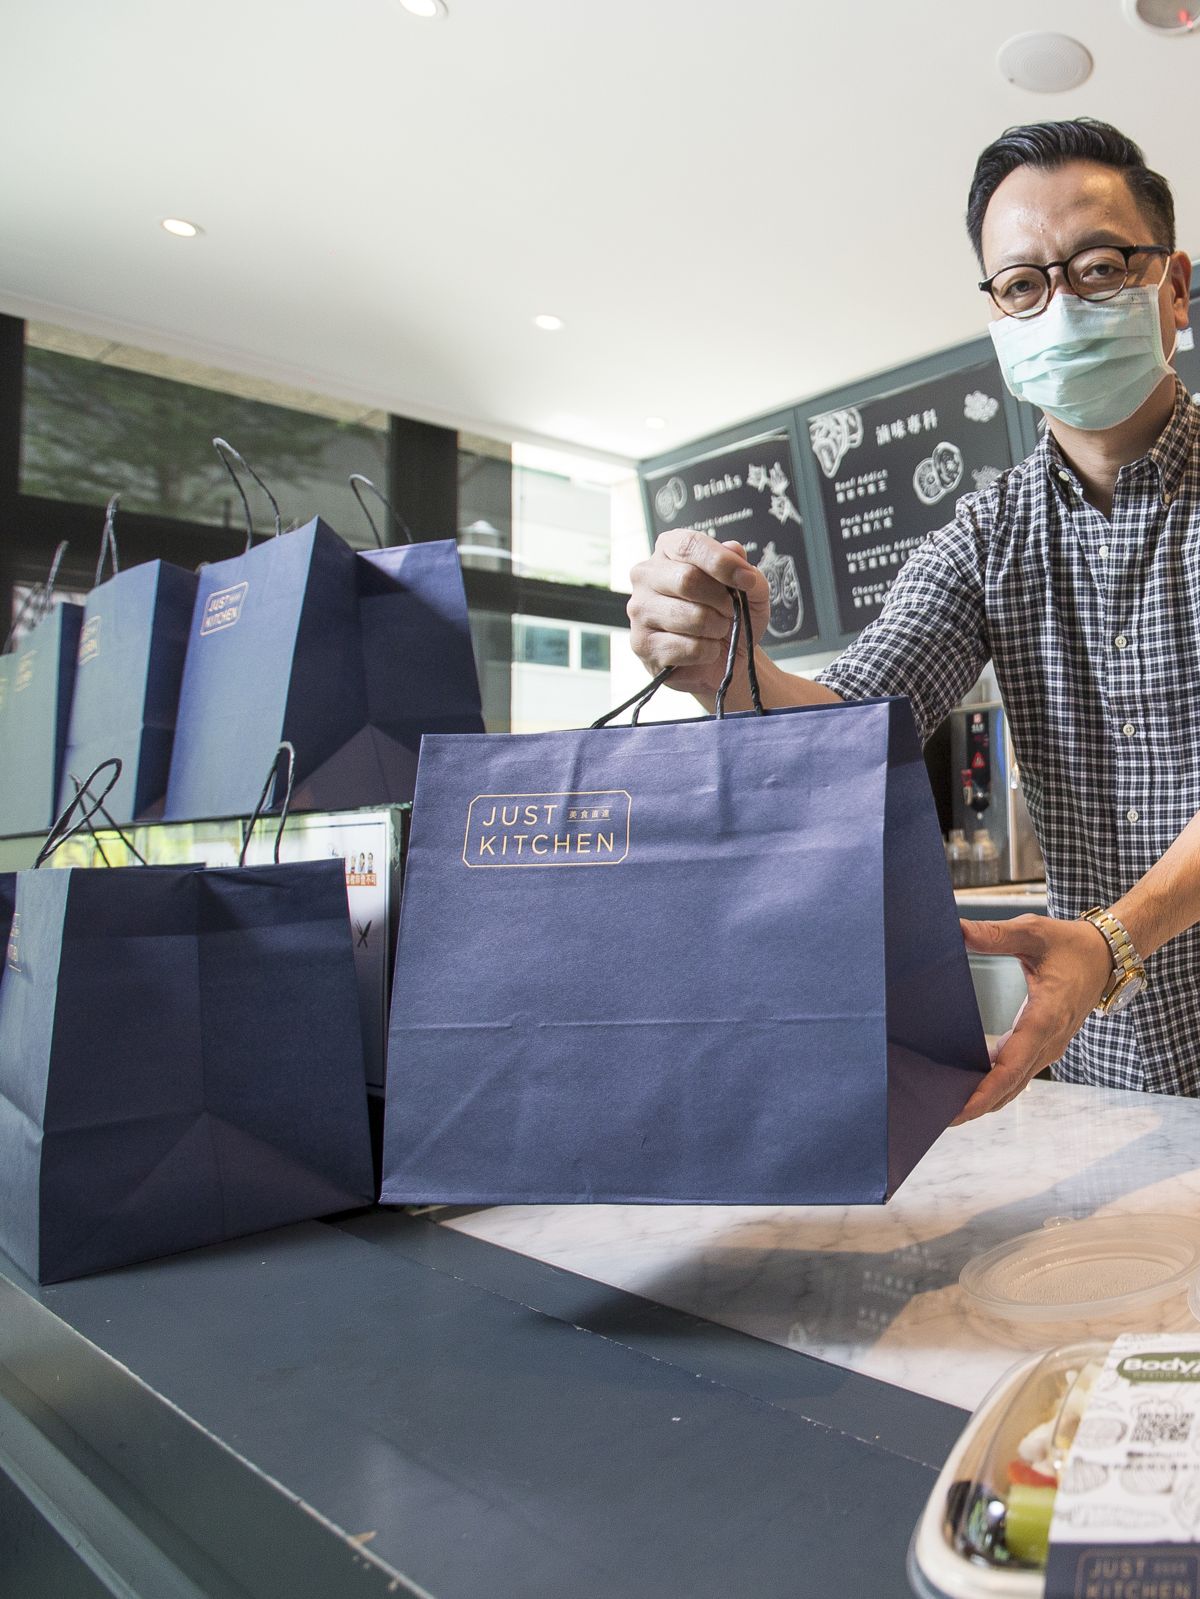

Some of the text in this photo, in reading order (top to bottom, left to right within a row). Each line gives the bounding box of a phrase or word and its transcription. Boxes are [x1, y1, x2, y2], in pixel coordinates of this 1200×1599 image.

[693, 473, 742, 501] Drinks
[482, 804, 558, 826] JUST
[479, 833, 614, 855] KITCHEN
[1089, 1557, 1145, 1579] JUST
